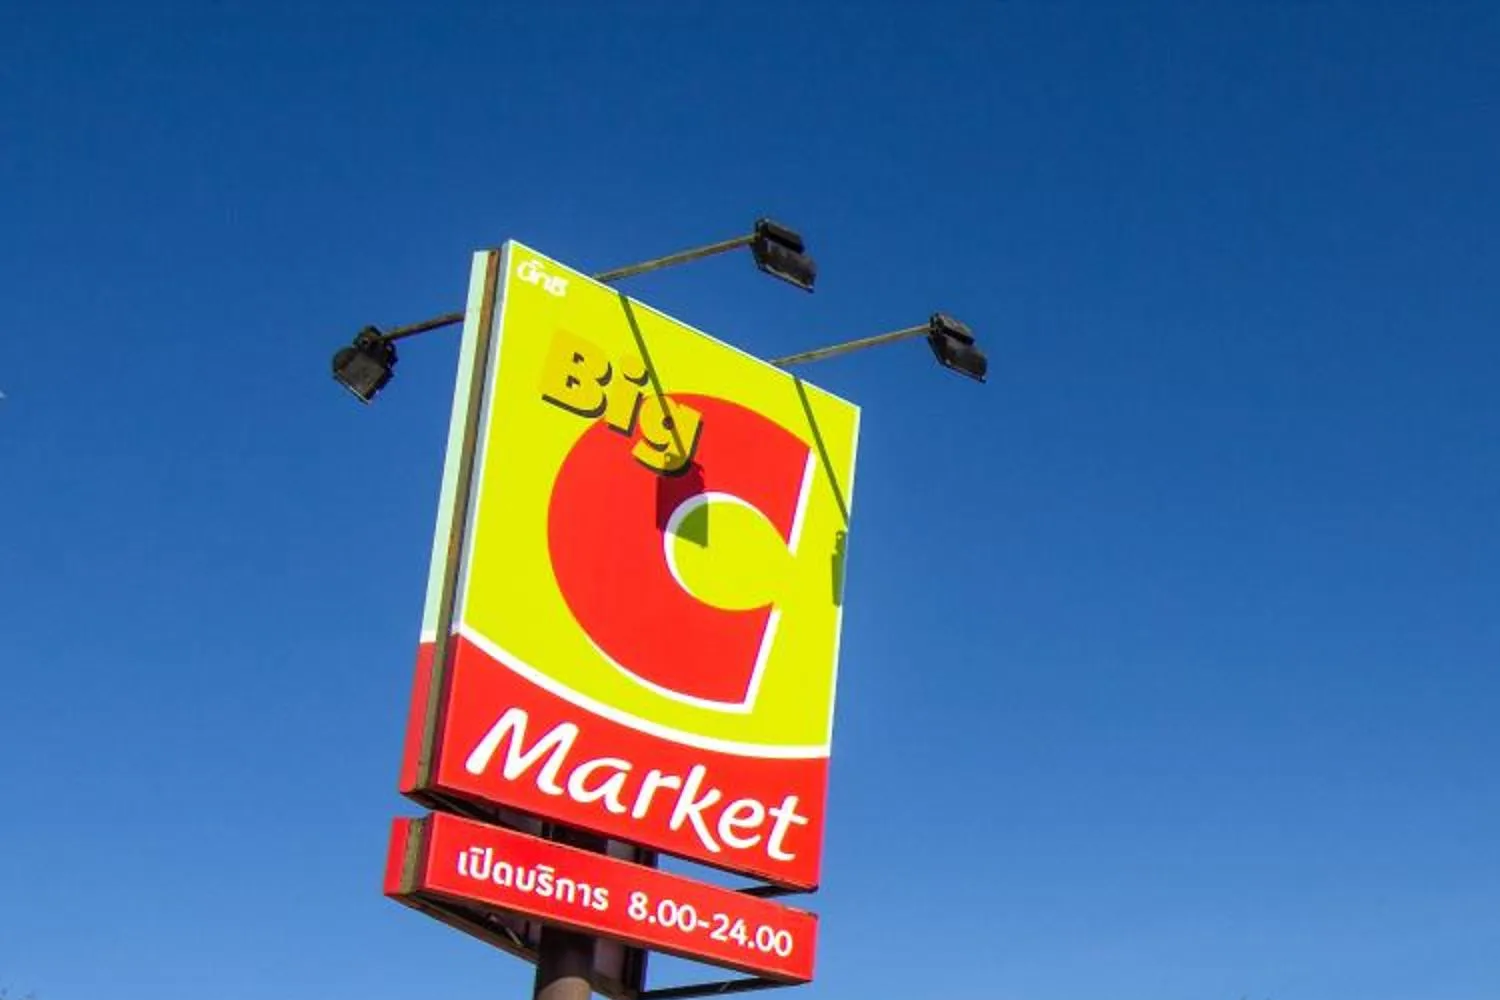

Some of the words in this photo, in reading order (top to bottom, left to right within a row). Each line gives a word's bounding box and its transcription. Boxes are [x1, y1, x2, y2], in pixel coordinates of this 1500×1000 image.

[538, 326, 704, 475] Big
[547, 391, 815, 714] C
[465, 706, 809, 862] Market
[456, 846, 610, 912] เปิดบริการ
[627, 892, 793, 957] 8.00-24.00
